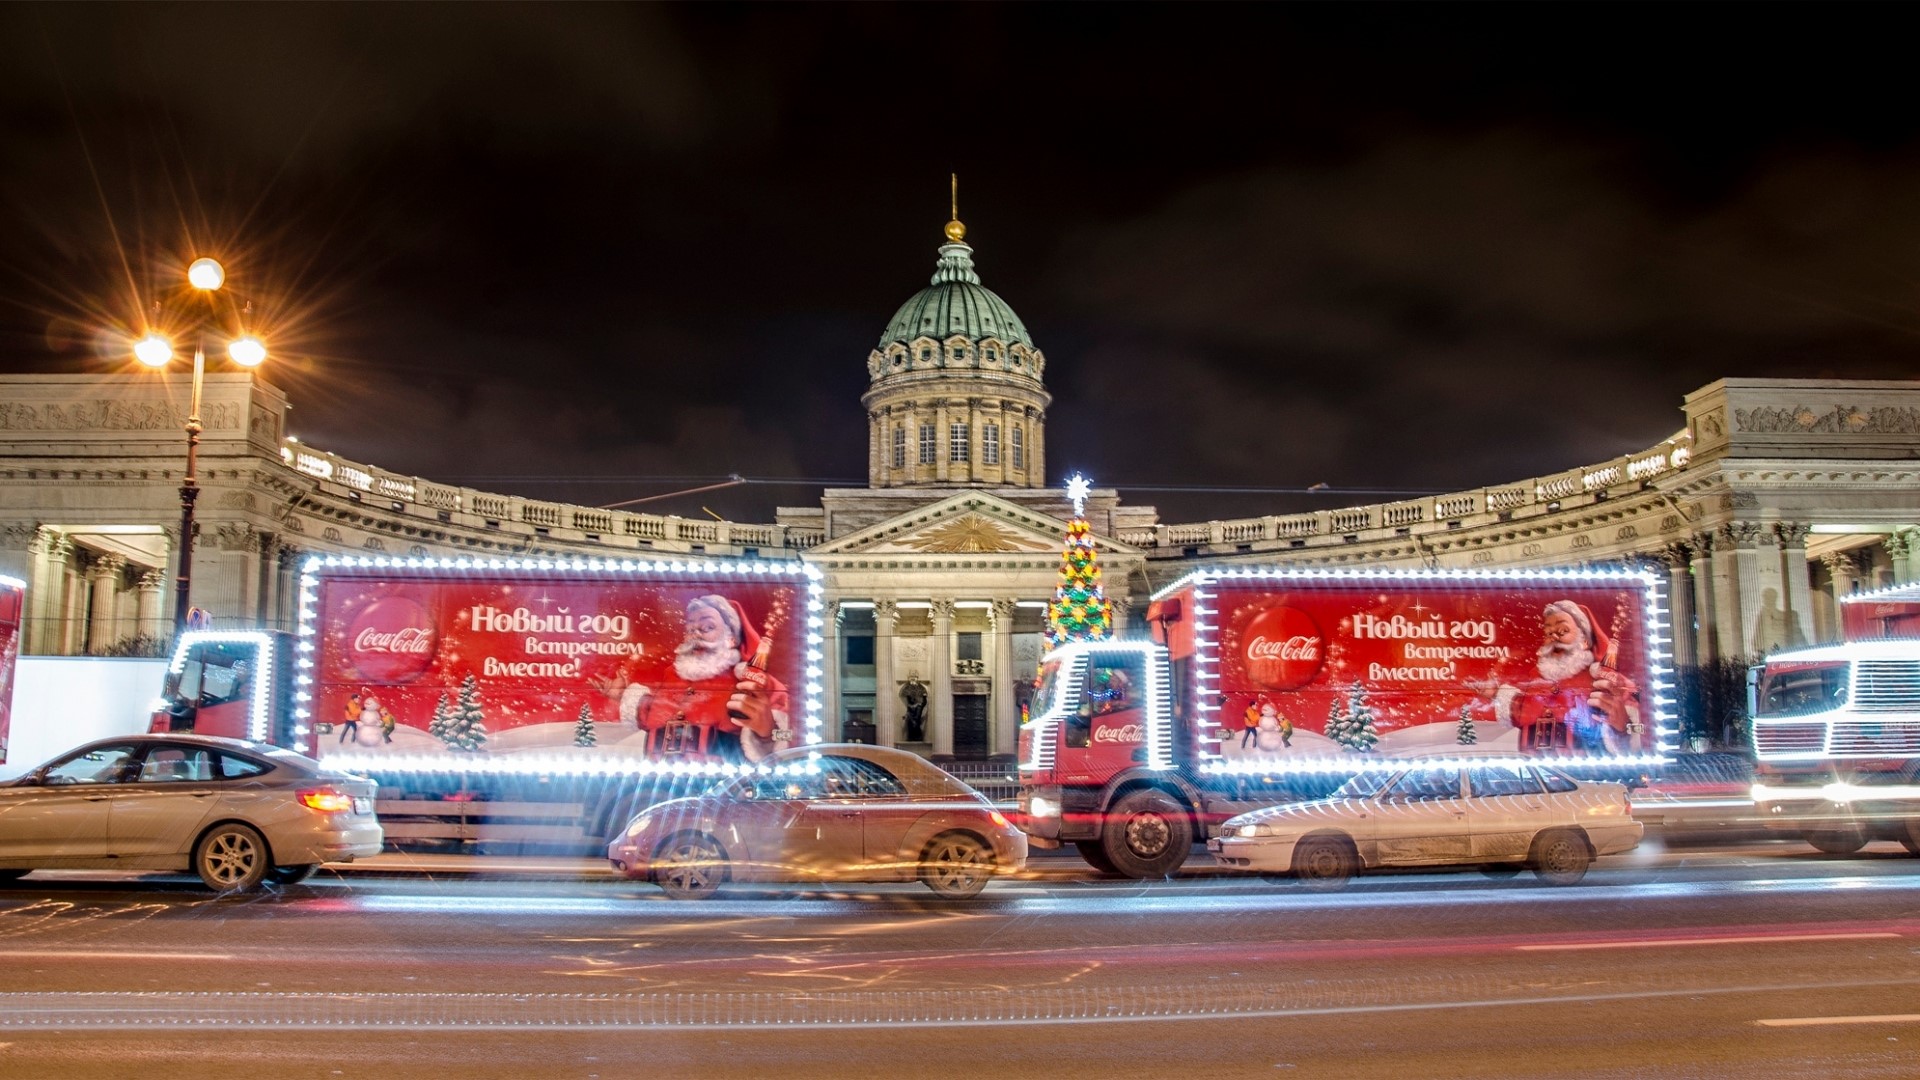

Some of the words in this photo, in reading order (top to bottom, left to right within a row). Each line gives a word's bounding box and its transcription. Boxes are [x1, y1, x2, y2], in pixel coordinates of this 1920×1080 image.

[471, 606, 574, 633] Новый
[578, 615, 630, 640] год
[1352, 613, 1447, 638] Новый
[1450, 621, 1496, 644] год
[354, 627, 433, 653] Coca-Cola
[525, 637, 644, 658] встречаем
[1247, 635, 1320, 660] Coca-Cola
[1404, 643, 1510, 662] встречаем
[483, 657, 581, 678] вместе!
[1368, 661, 1457, 681] вместе!
[1094, 724, 1144, 743] Coca-Cola
